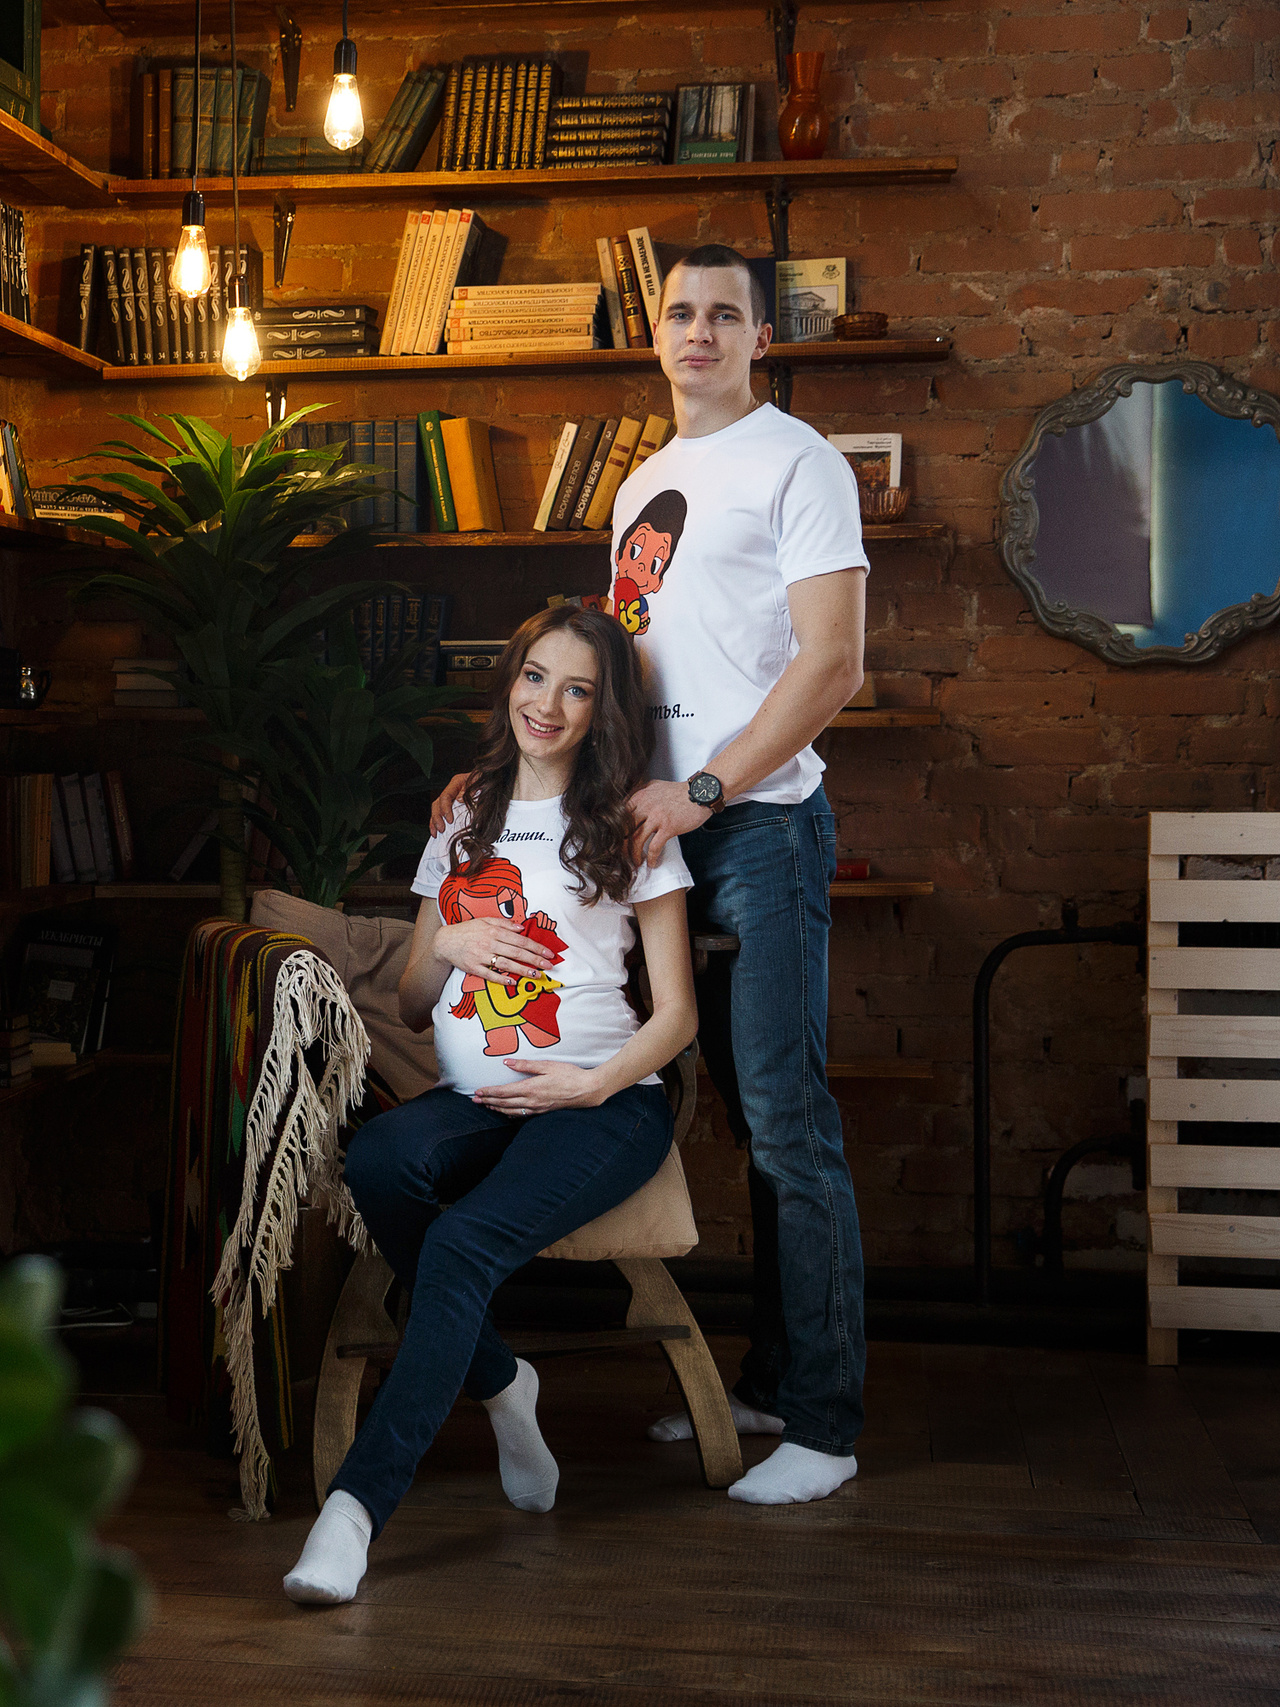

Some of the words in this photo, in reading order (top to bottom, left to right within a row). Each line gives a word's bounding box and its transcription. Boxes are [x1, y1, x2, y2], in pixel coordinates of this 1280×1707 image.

[423, 215, 429, 223] 2
[636, 236, 650, 274] НЕЗНАЕМОЕ
[645, 278, 656, 297] ПУТИ
[479, 328, 528, 337] РУКОВОДСТВО
[531, 327, 582, 336] ПРАКТИЧЕСКОЕ
[143, 352, 151, 360] 30
[158, 352, 166, 360] 34
[185, 351, 194, 359] 36
[200, 351, 208, 359] 37
[584, 431, 591, 440] 2
[605, 431, 612, 439] 3
[556, 484, 573, 520] ВАСИЛИЙ
[568, 460, 581, 485] БЕЛОВ
[574, 484, 592, 519] ВАСИЛИЙ
[587, 460, 602, 485] БЕЛОВ
[38, 930, 104, 947] ДЕКАБРИСТЫ
